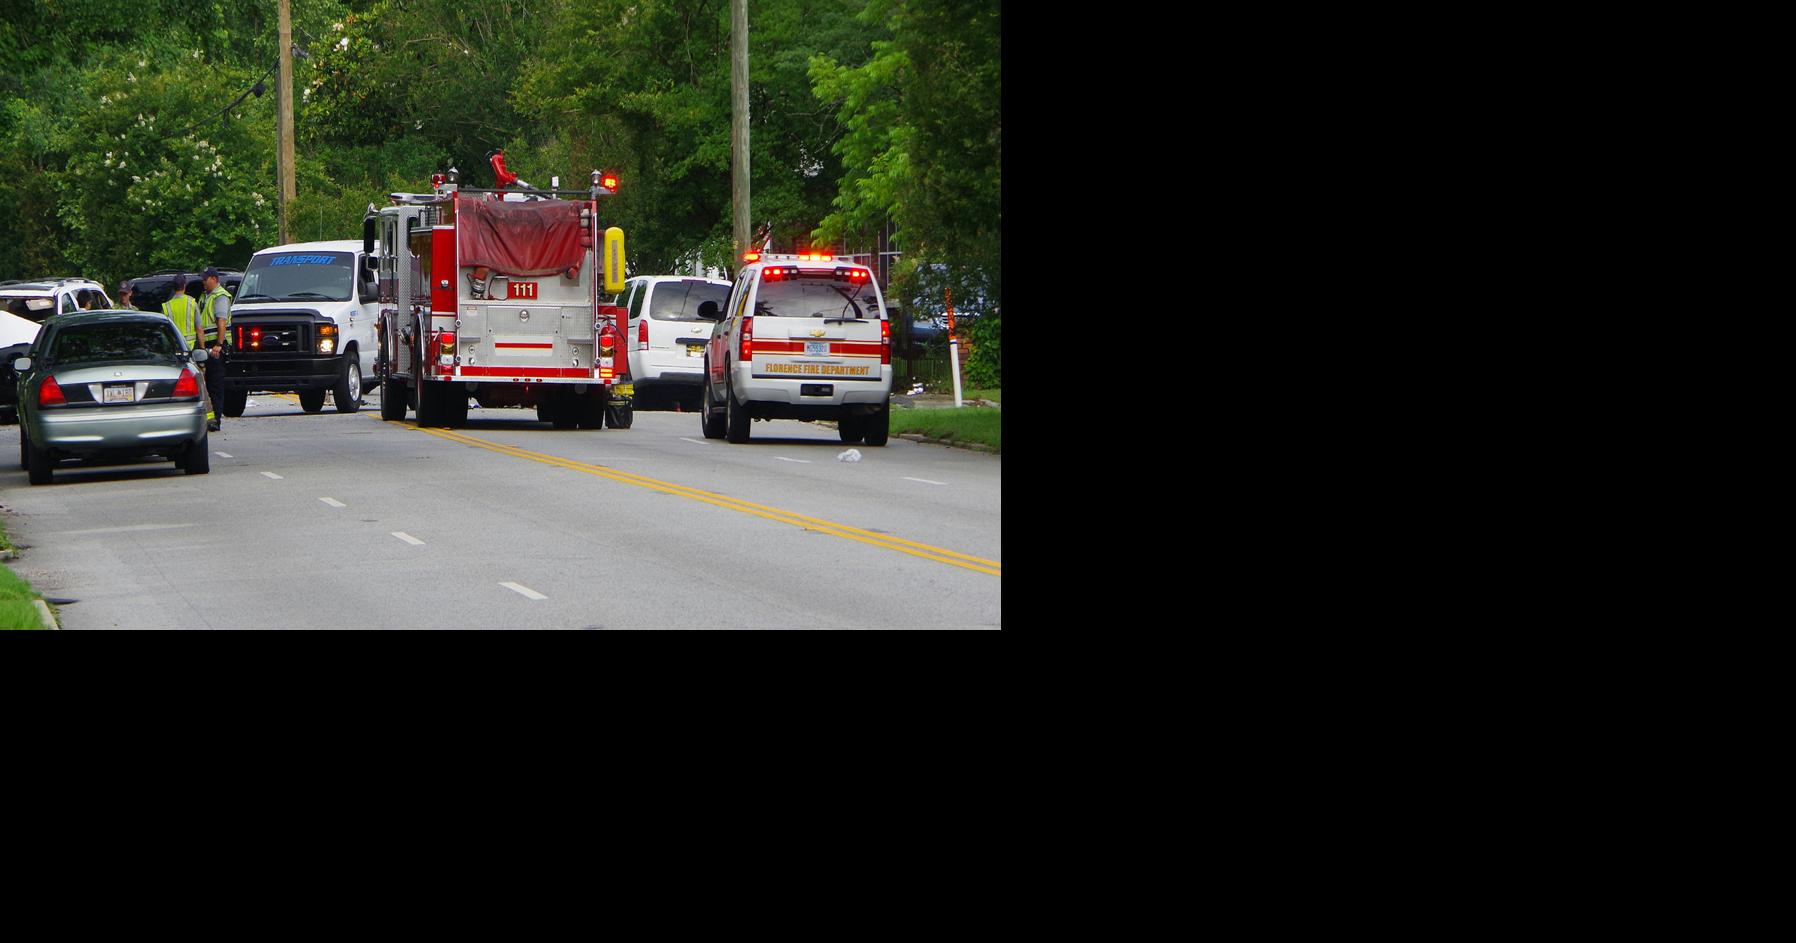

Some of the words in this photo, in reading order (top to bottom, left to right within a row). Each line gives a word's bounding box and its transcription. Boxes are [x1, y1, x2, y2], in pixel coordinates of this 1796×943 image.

[270, 255, 337, 266] TRANSPORT
[513, 283, 533, 297] 111
[766, 363, 802, 374] FLORENCE
[803, 364, 820, 375] FIRE
[821, 365, 870, 376] DEPARTMENT
